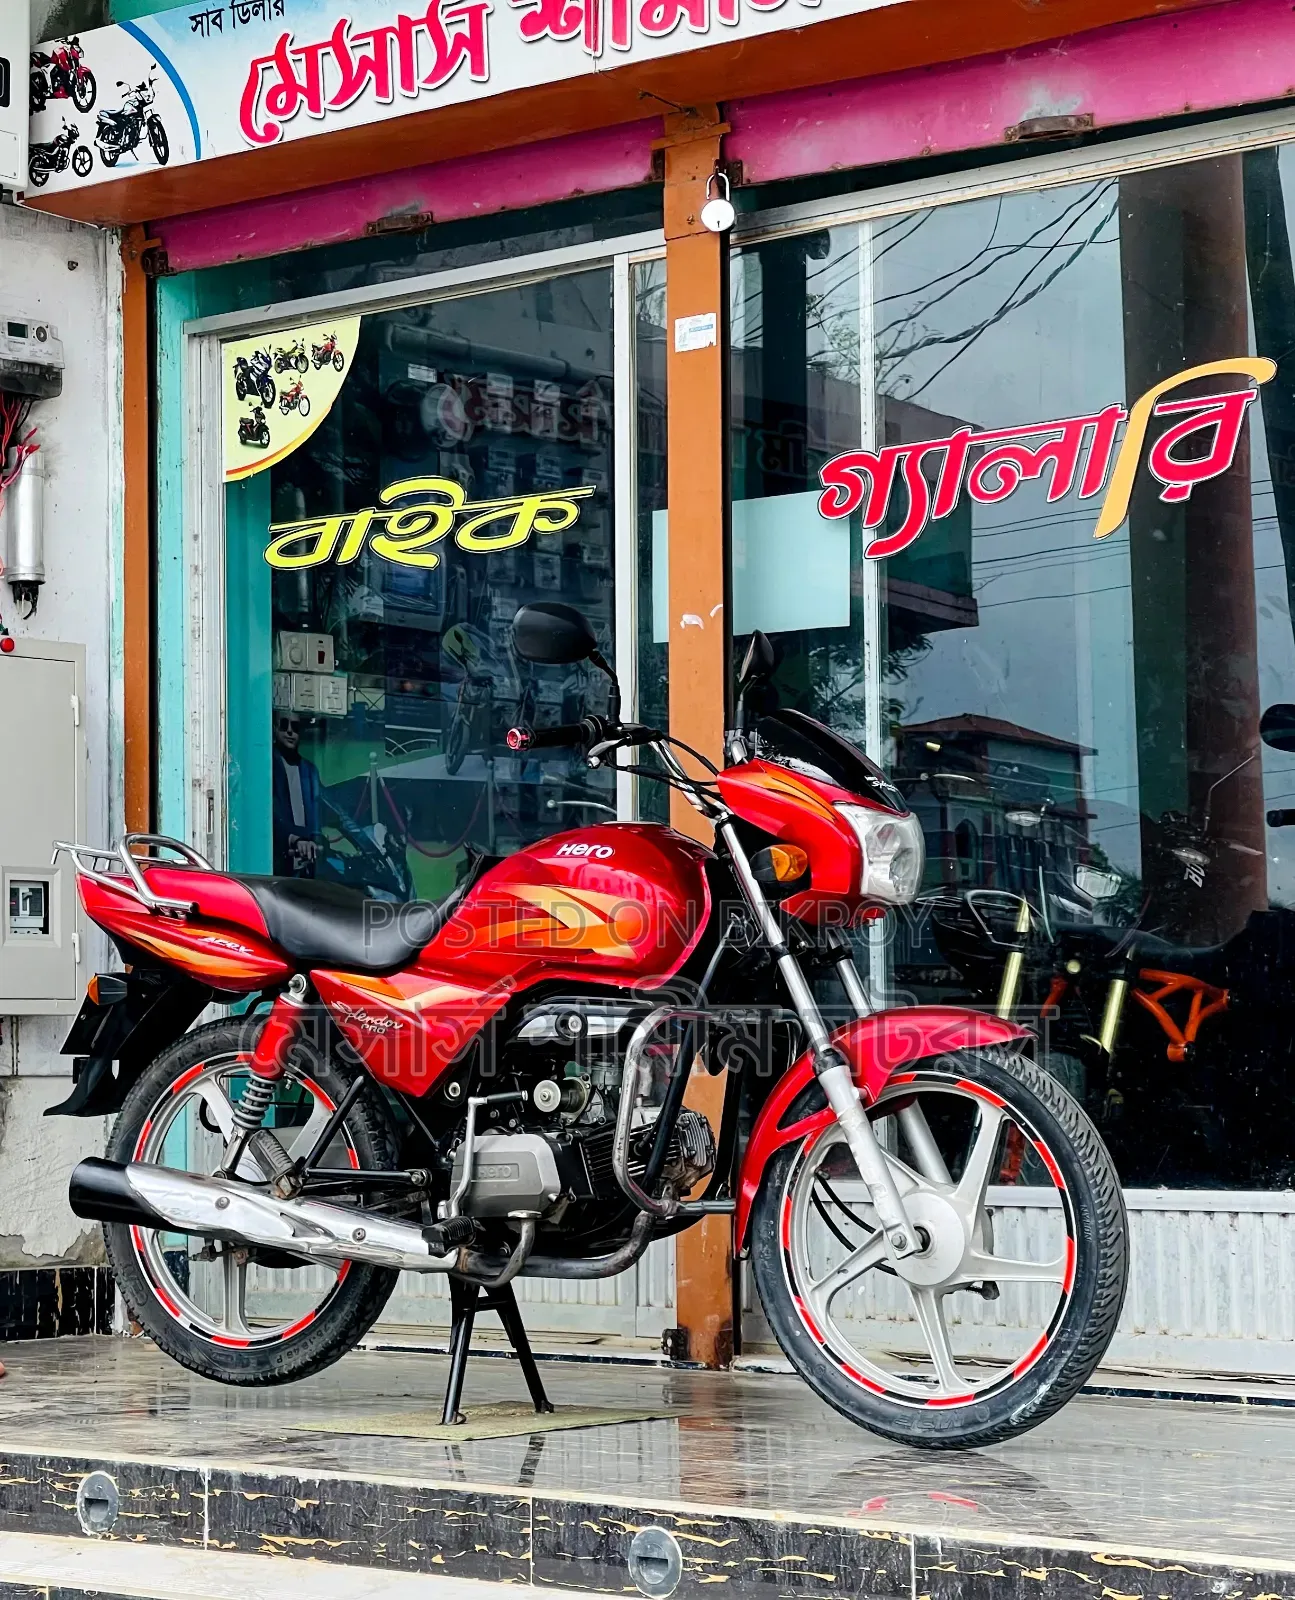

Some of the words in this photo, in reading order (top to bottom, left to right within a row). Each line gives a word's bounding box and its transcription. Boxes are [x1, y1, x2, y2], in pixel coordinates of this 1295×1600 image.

[817, 356, 1278, 561] গ্যালারি
[263, 476, 597, 570] বাইক
[555, 843, 614, 859] Hero
